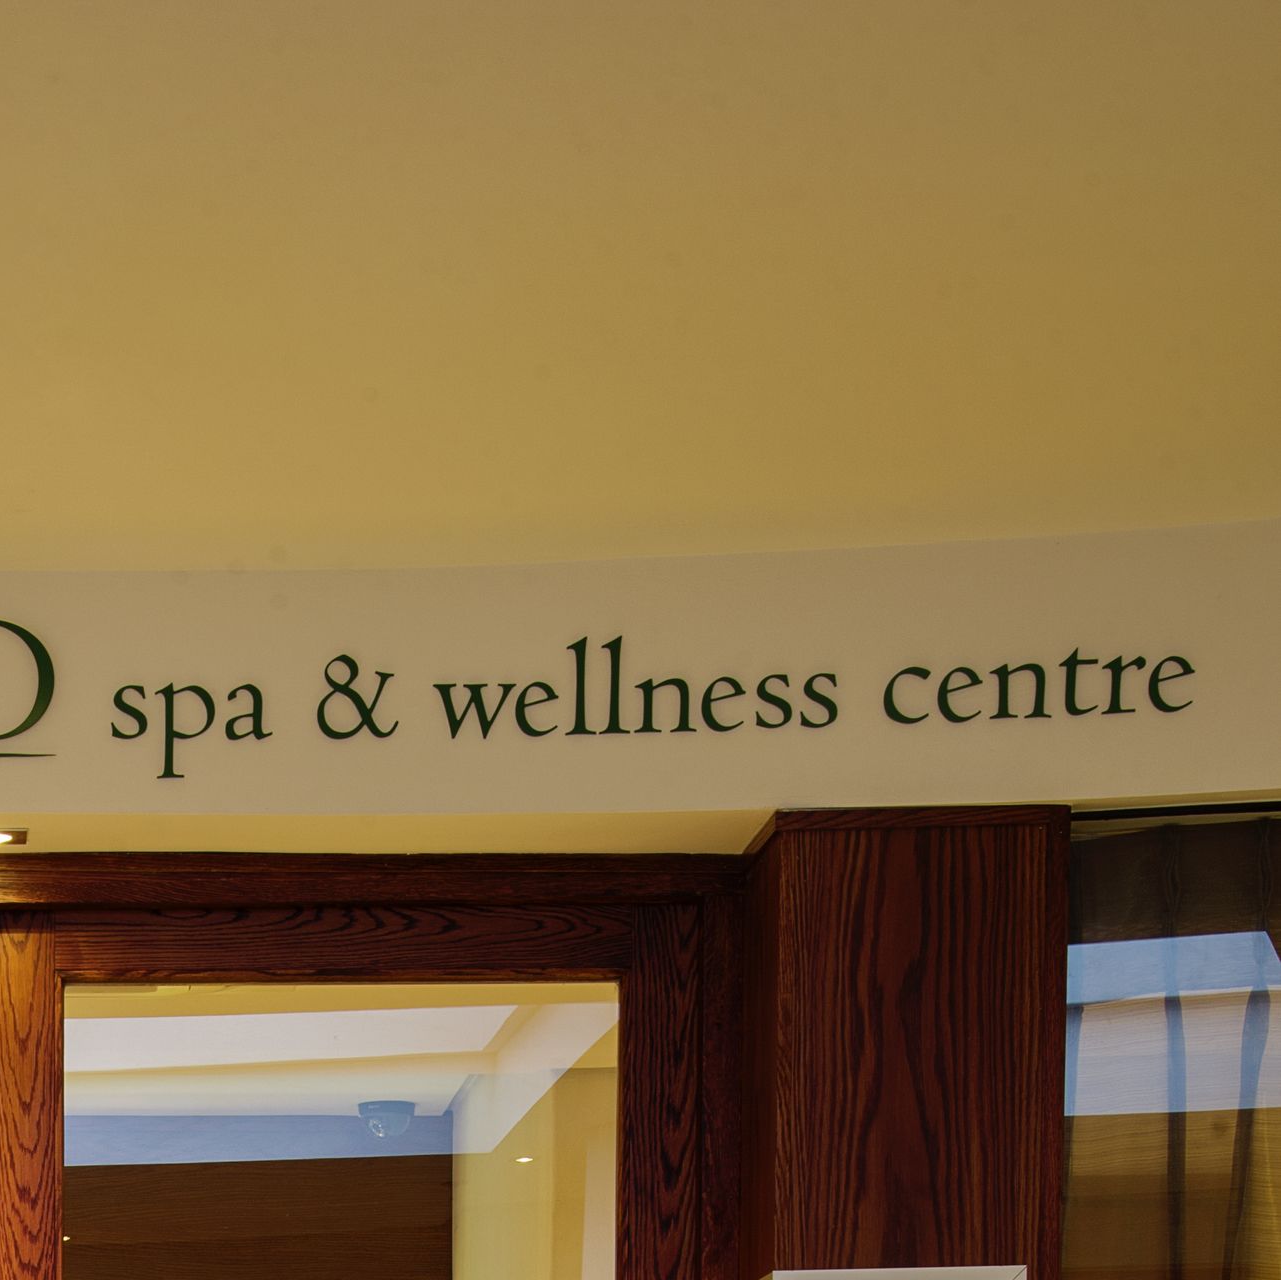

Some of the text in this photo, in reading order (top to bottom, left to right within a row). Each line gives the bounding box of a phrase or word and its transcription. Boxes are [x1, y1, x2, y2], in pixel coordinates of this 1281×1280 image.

[110, 679, 273, 779] spa
[316, 653, 400, 741] &
[433, 634, 839, 741] wellness
[882, 645, 1197, 725] centre
